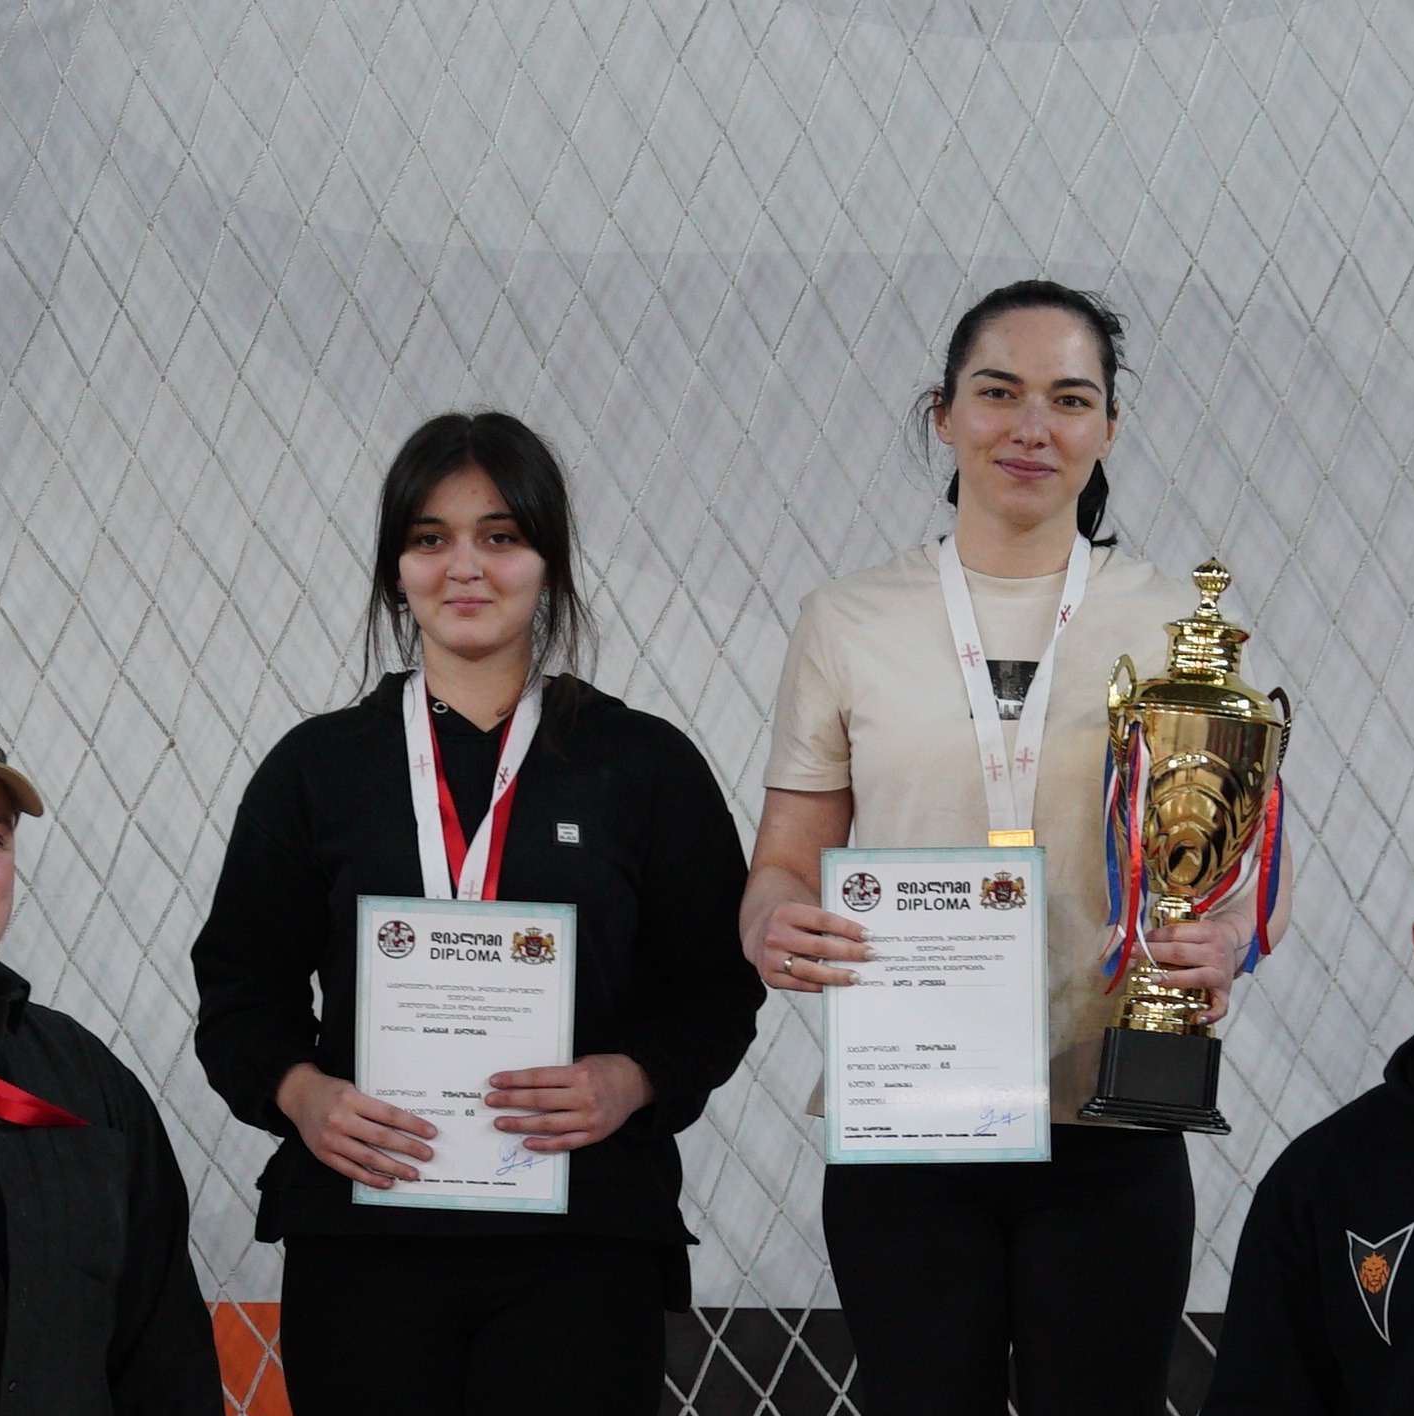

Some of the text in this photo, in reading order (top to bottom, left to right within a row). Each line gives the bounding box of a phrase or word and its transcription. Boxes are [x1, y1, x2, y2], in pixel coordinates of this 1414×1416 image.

[897, 880, 971, 894] დიპლომი
[897, 897, 971, 911] DIPLOMA
[431, 931, 502, 947] დიპლომი
[430, 947, 502, 963] DIPLOMA
